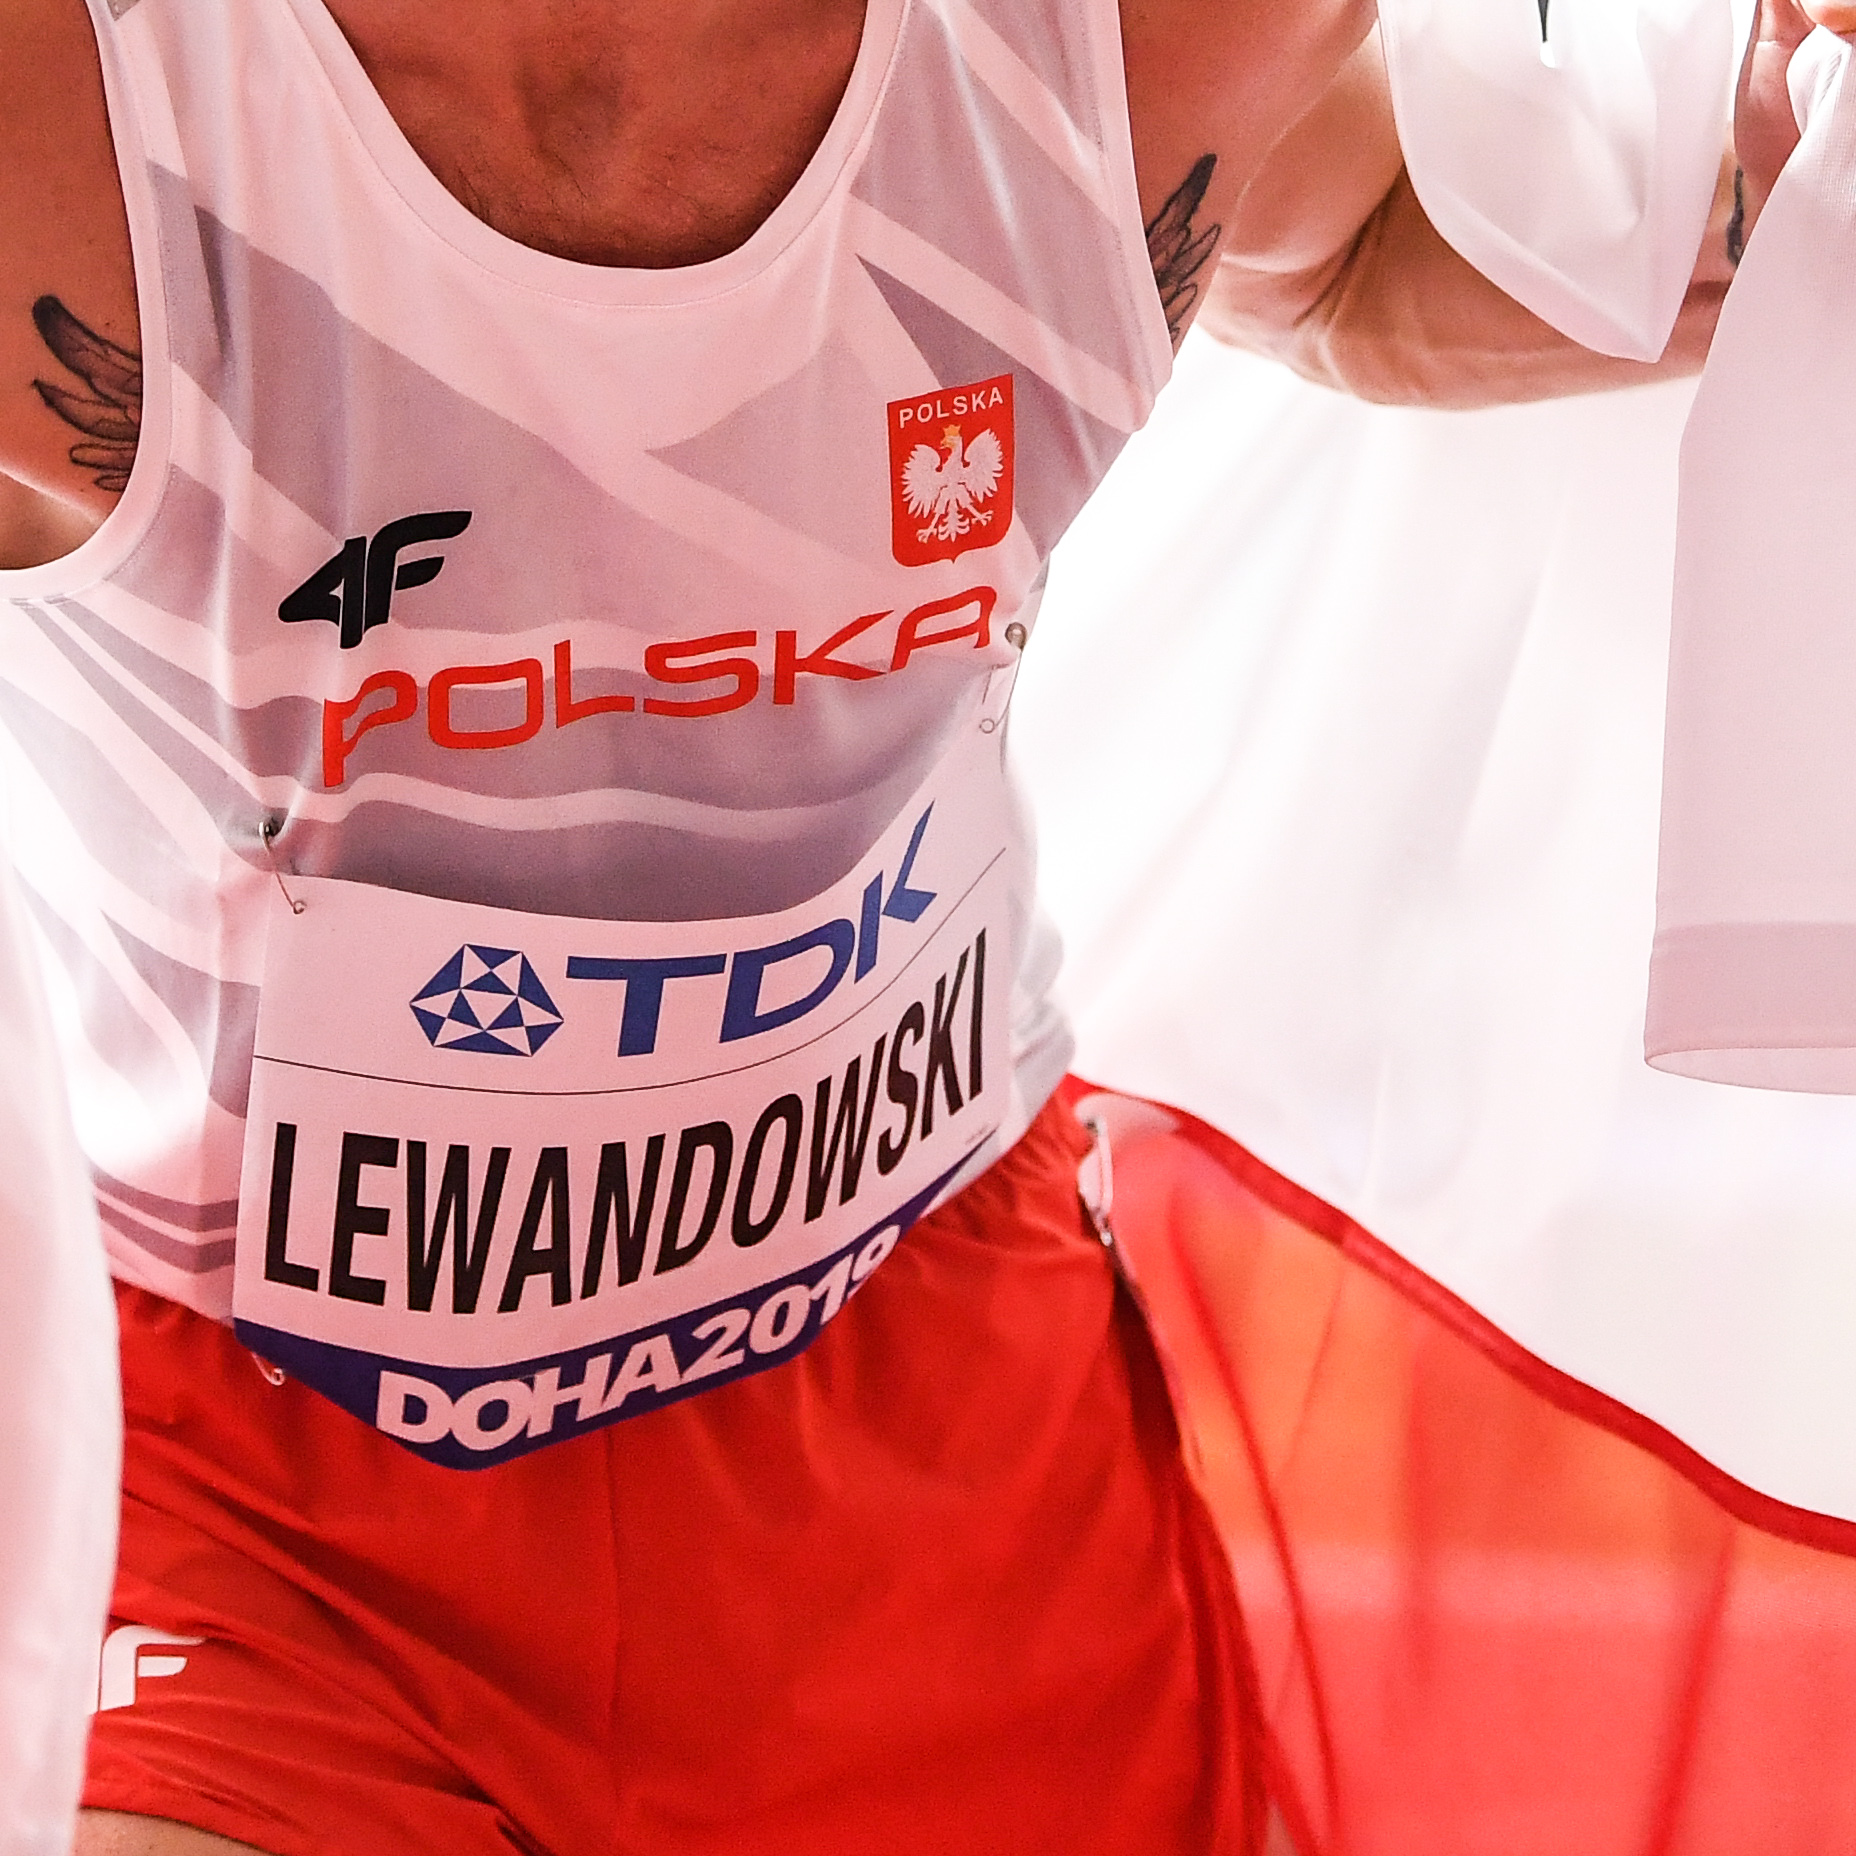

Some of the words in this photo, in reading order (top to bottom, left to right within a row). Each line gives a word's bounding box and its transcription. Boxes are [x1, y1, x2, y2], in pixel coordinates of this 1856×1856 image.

[899, 386, 1004, 429] POLSKA
[278, 510, 472, 649] 4F
[322, 585, 996, 786] POLSKA
[566, 800, 937, 1056] TDK
[262, 926, 988, 1315] LEWANDOWSKI
[86, 1624, 207, 1713] F
